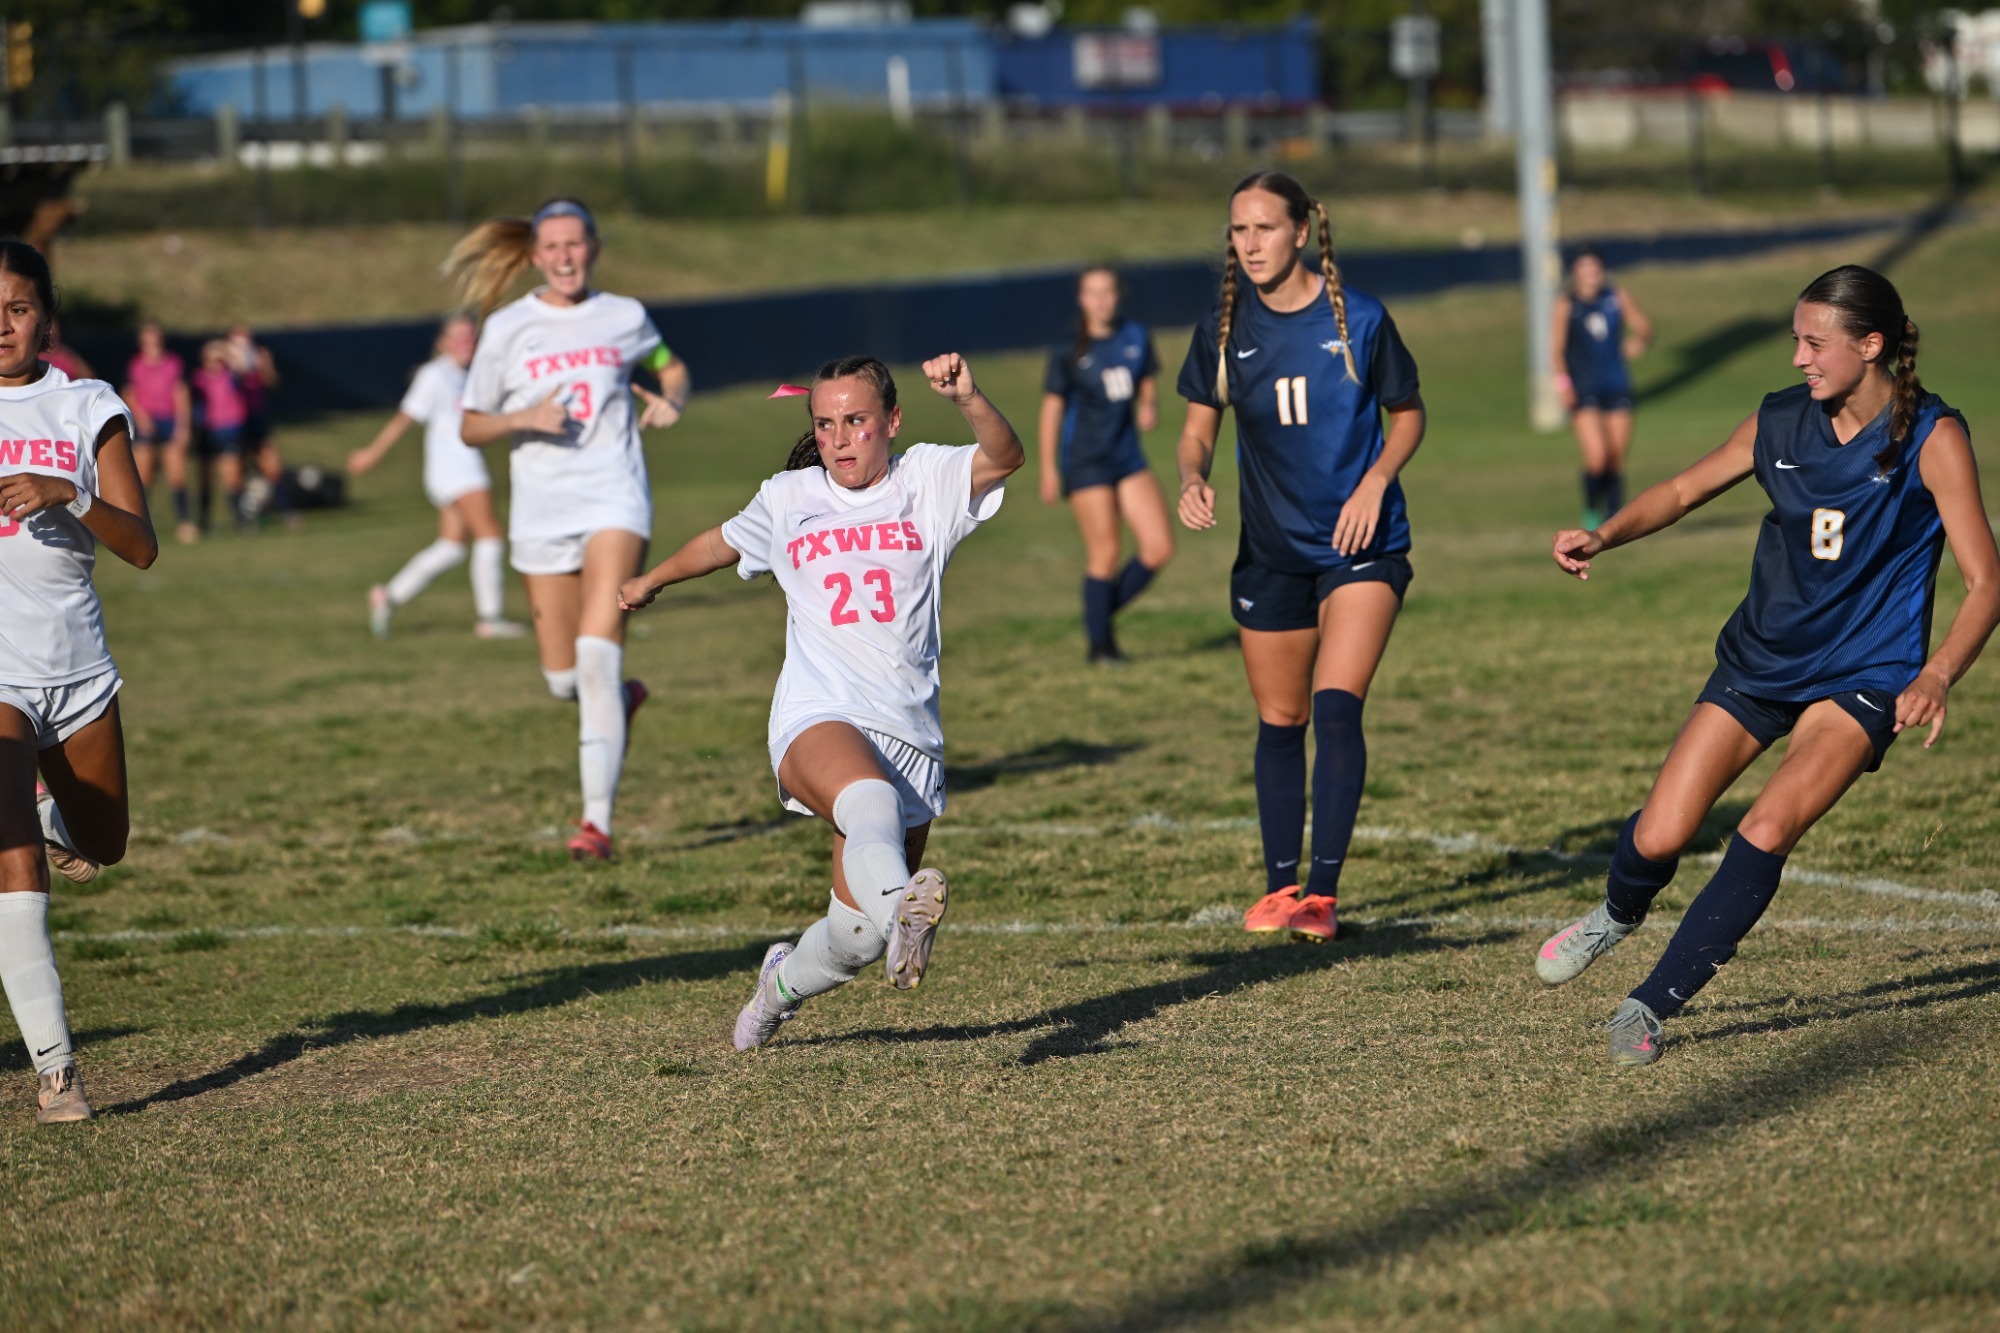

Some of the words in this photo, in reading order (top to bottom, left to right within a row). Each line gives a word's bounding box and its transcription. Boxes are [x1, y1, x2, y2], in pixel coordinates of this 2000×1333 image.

[524, 346, 624, 380] TXWES
[570, 380, 593, 421] 3
[1275, 376, 1308, 426] 11
[786, 520, 923, 571] TXWES
[1811, 508, 1845, 561] 8
[823, 568, 896, 627] 23
